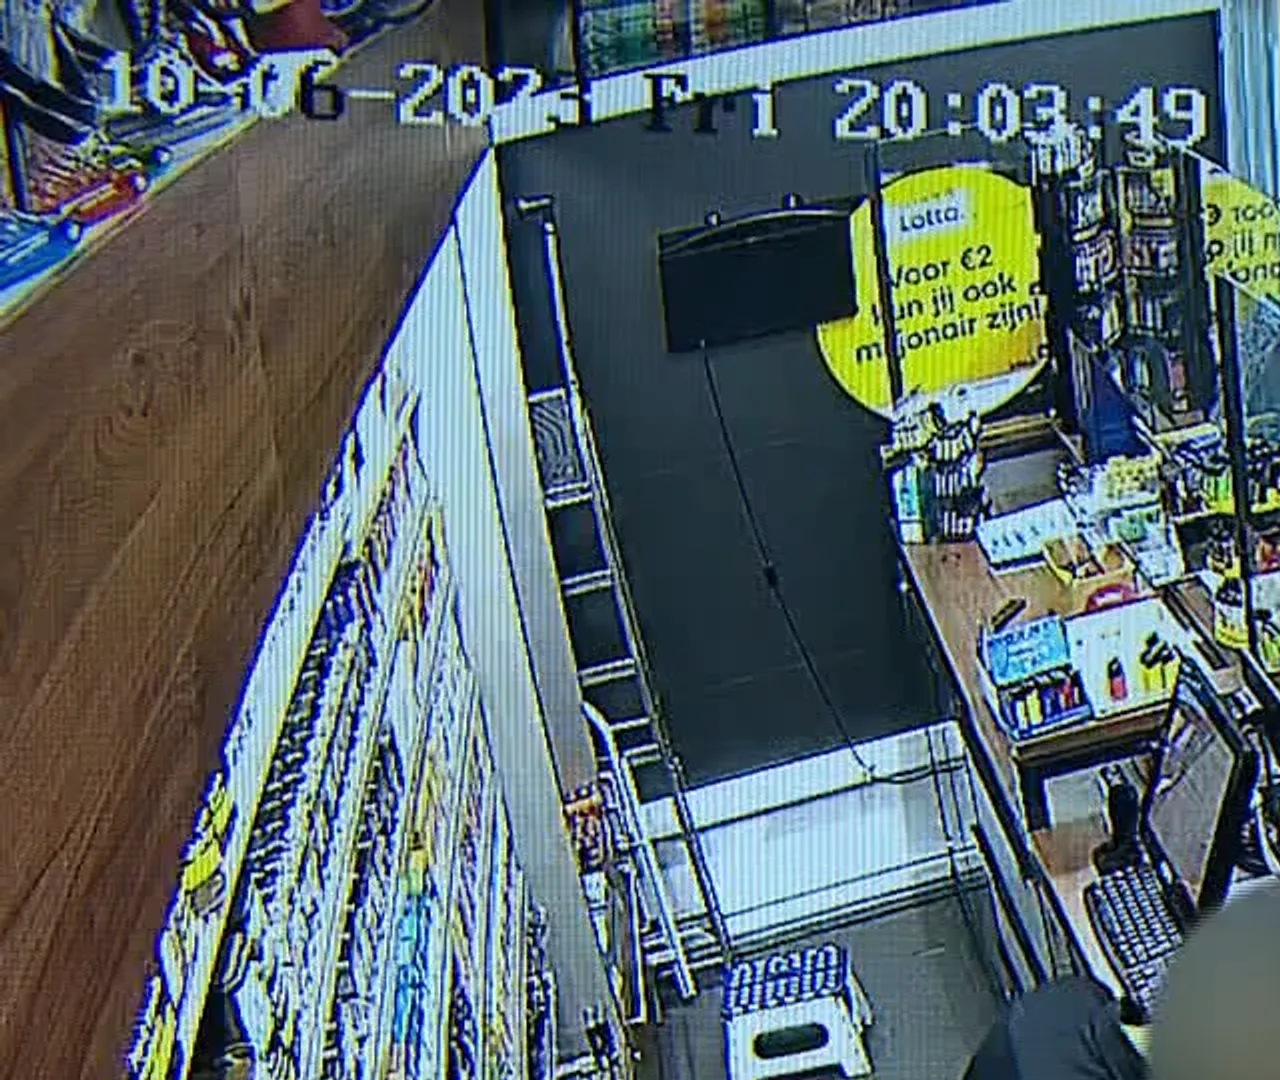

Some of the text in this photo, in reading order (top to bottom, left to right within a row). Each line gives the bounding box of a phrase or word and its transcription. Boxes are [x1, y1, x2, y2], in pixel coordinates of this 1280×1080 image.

[961, 244, 993, 271] €2
[932, 288, 955, 319] jij
[962, 271, 1017, 302] ook
[987, 297, 1041, 332] zijn!
